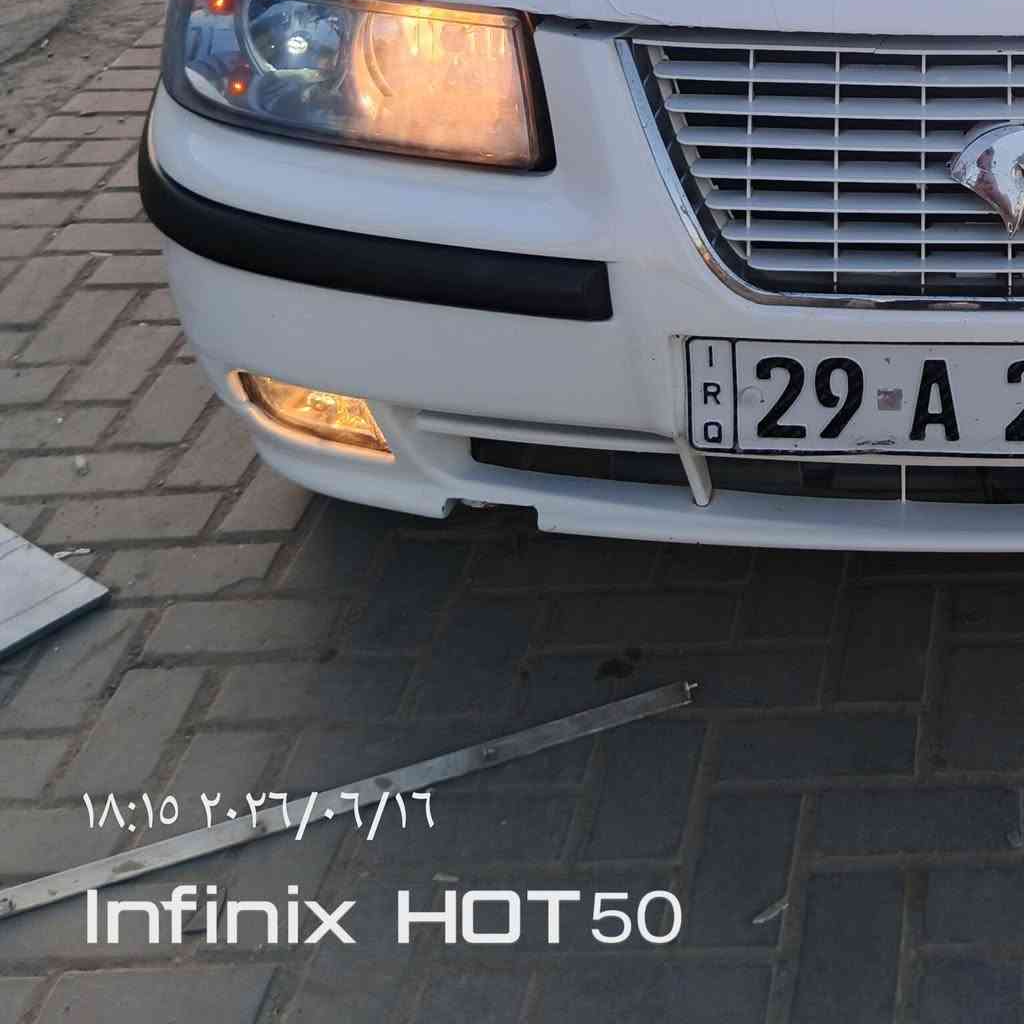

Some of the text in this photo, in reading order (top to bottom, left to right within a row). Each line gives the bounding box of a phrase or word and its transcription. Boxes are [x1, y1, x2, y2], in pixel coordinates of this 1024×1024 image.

[702, 345, 723, 444] IRQ
[755, 356, 864, 440] 29
[908, 359, 961, 442] A
